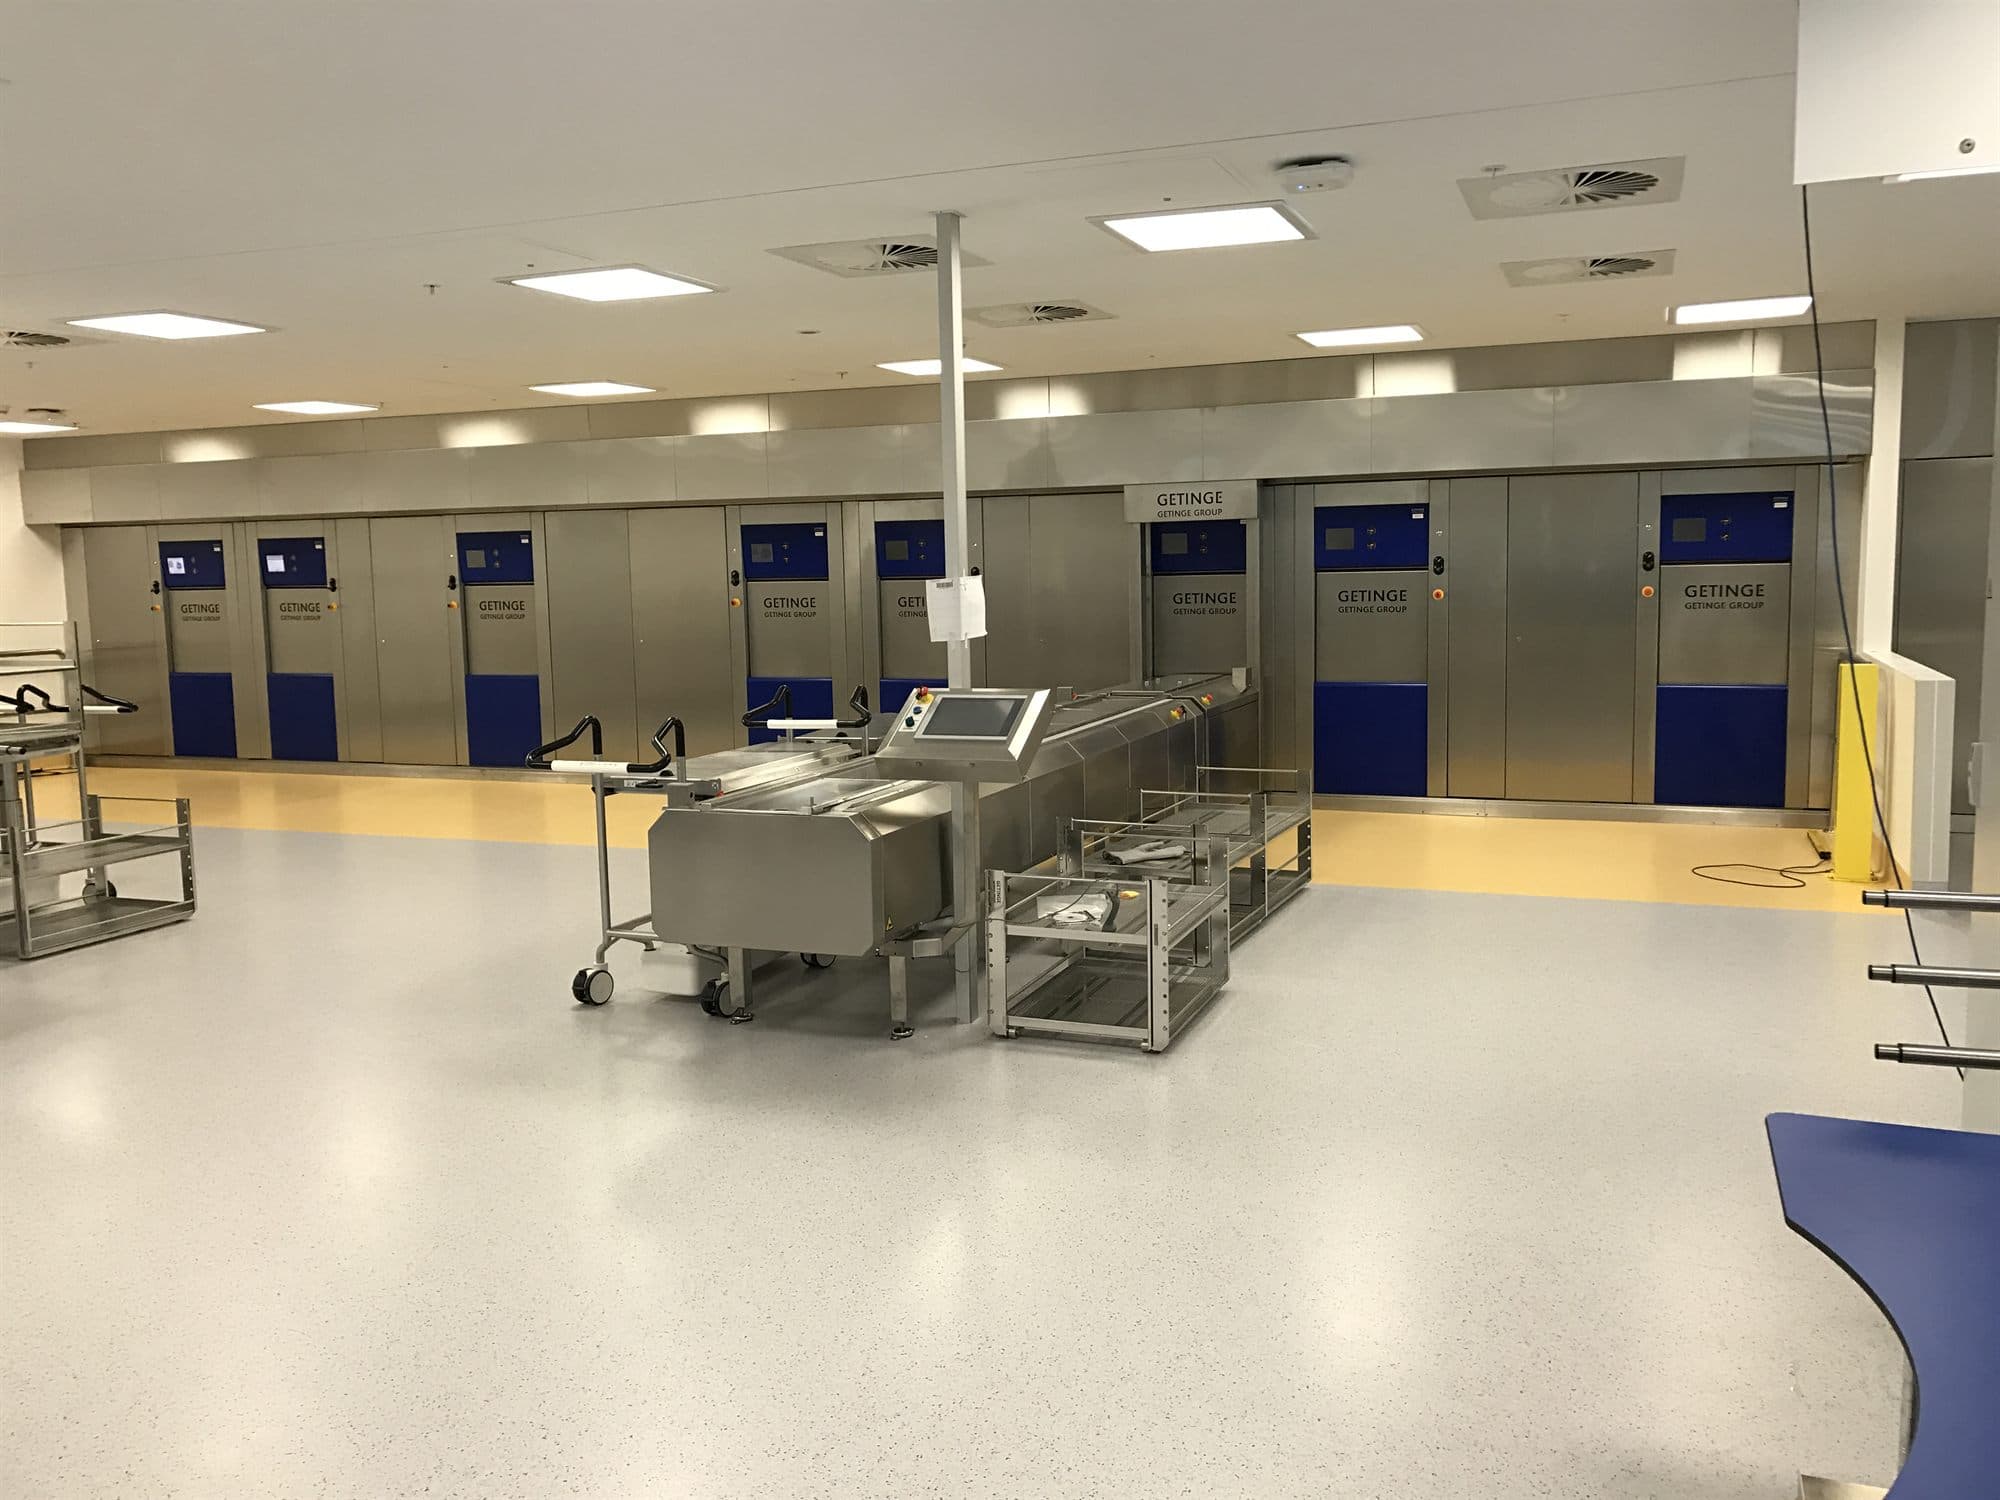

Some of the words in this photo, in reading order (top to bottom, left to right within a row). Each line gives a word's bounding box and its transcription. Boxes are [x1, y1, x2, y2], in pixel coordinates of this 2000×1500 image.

[1157, 491, 1223, 506] GETINGE
[1157, 510, 1191, 518] GETINGE
[1194, 508, 1223, 517] GROUP
[1338, 589, 1408, 602] GETINGE
[1684, 584, 1765, 598] GETINGE
[763, 597, 816, 608] GETINGE
[897, 596, 925, 608] GETI
[1173, 592, 1237, 604] GETINGE
[180, 603, 220, 614] GETINGE
[279, 602, 320, 613] GETINGE
[479, 600, 525, 611] GETINGE
[1376, 605, 1408, 613] GROUP
[1684, 601, 1726, 609] GETINGE
[1728, 601, 1765, 609] GROUP
[1208, 607, 1237, 615] GROUP
